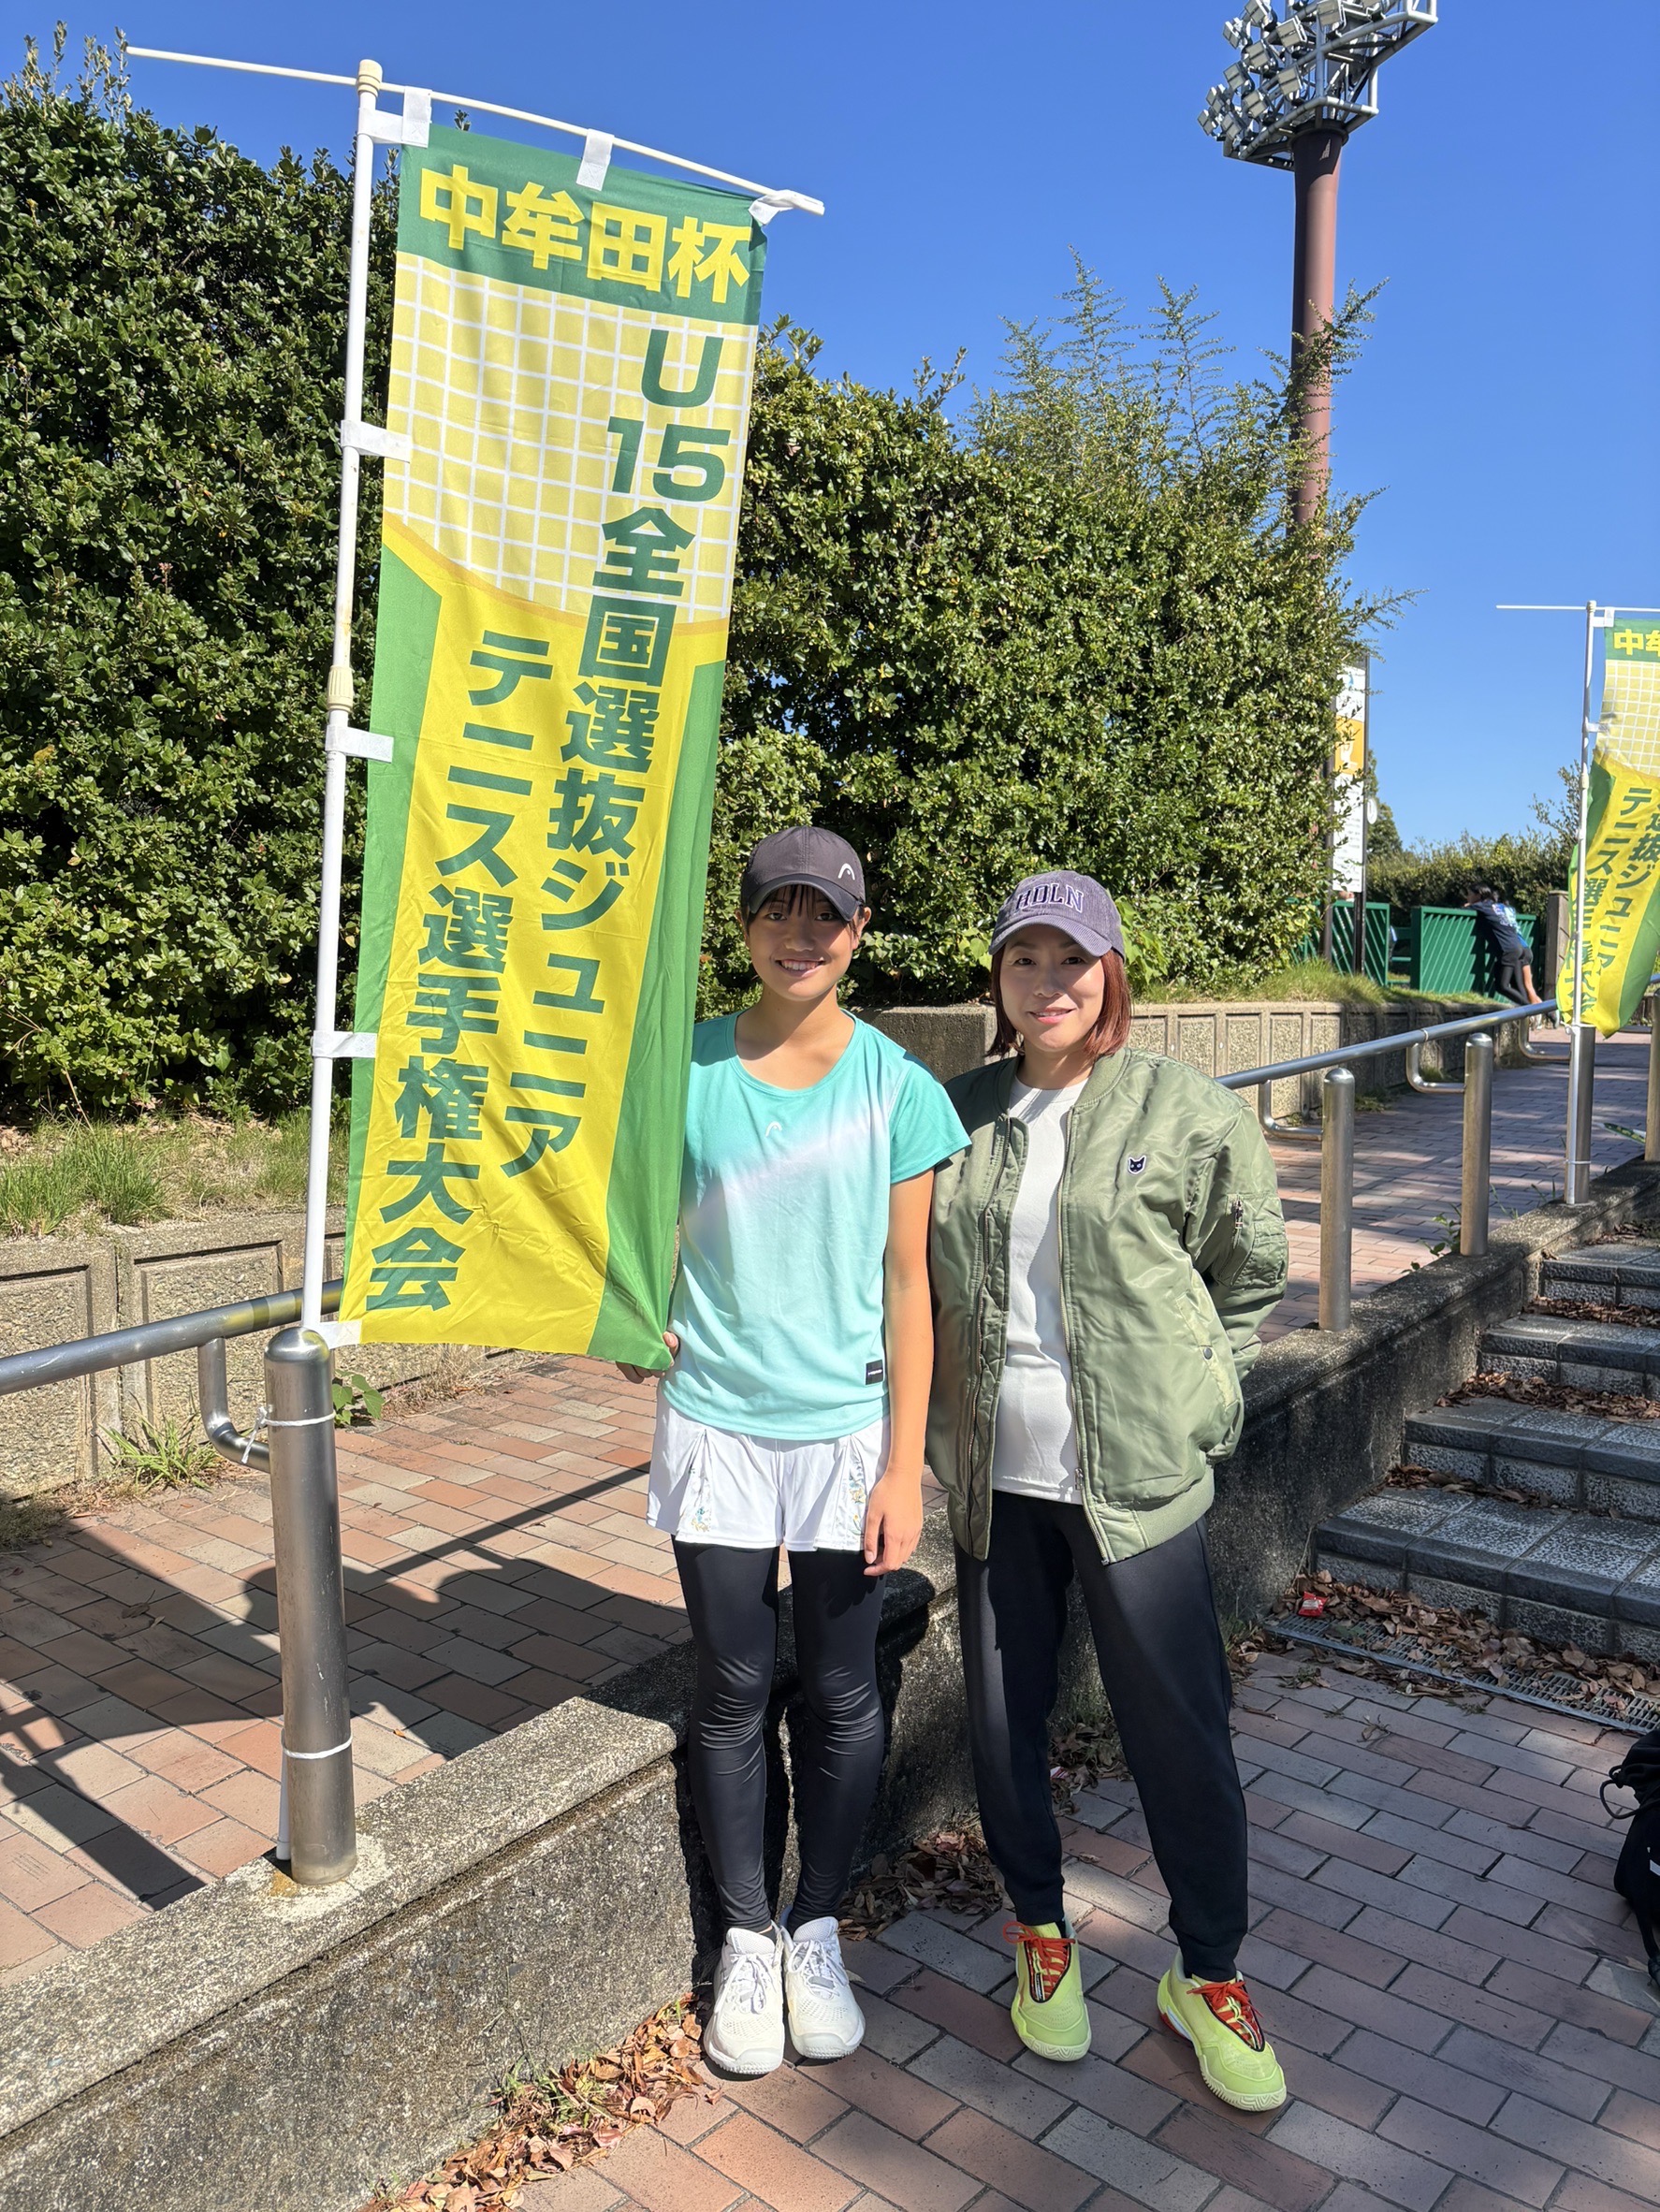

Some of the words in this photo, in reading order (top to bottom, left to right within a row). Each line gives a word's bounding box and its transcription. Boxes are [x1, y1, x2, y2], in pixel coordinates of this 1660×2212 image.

[419, 164, 752, 304] 中牟田杯
[366, 630, 554, 1312] テニス選手権大会
